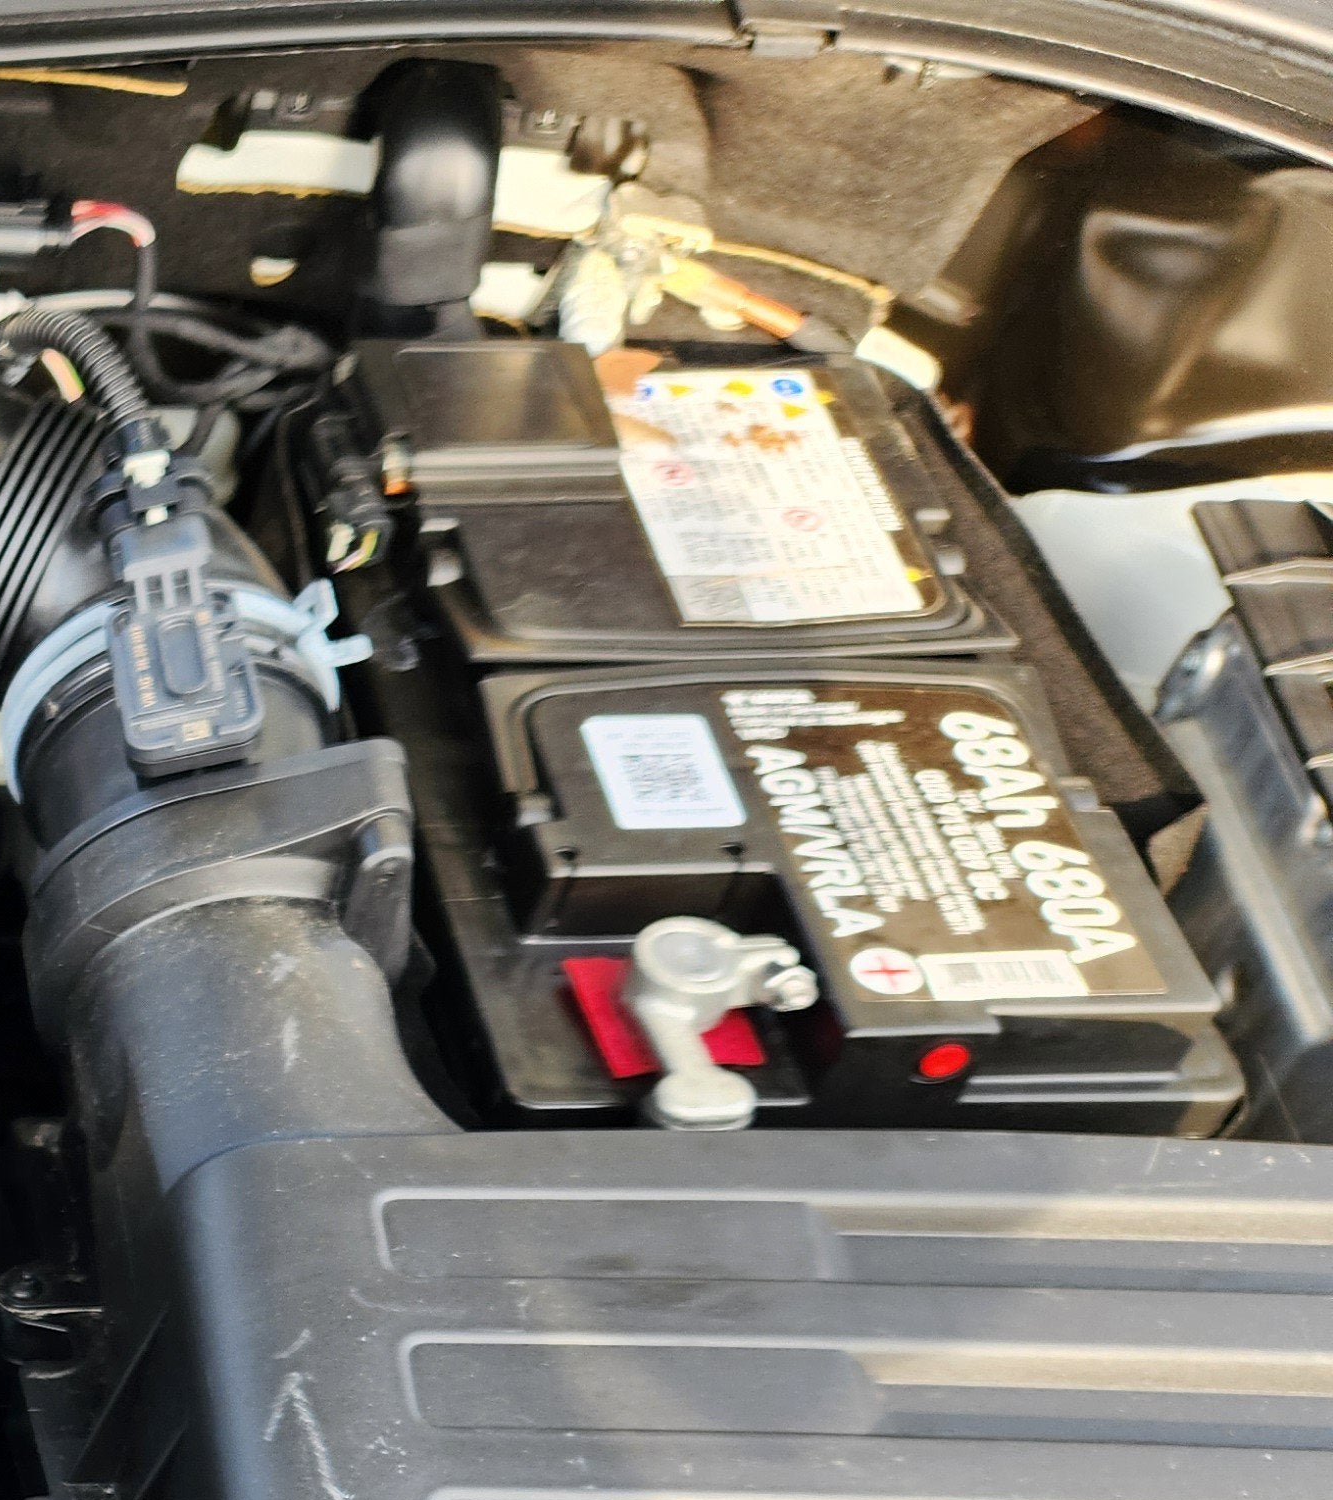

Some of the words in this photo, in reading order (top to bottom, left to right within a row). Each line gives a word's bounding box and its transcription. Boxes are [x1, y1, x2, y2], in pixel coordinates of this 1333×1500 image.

[745, 746, 884, 937] AGM/VRLA
[939, 712, 1060, 828] 68Ah
[1008, 841, 1139, 963] 680A
